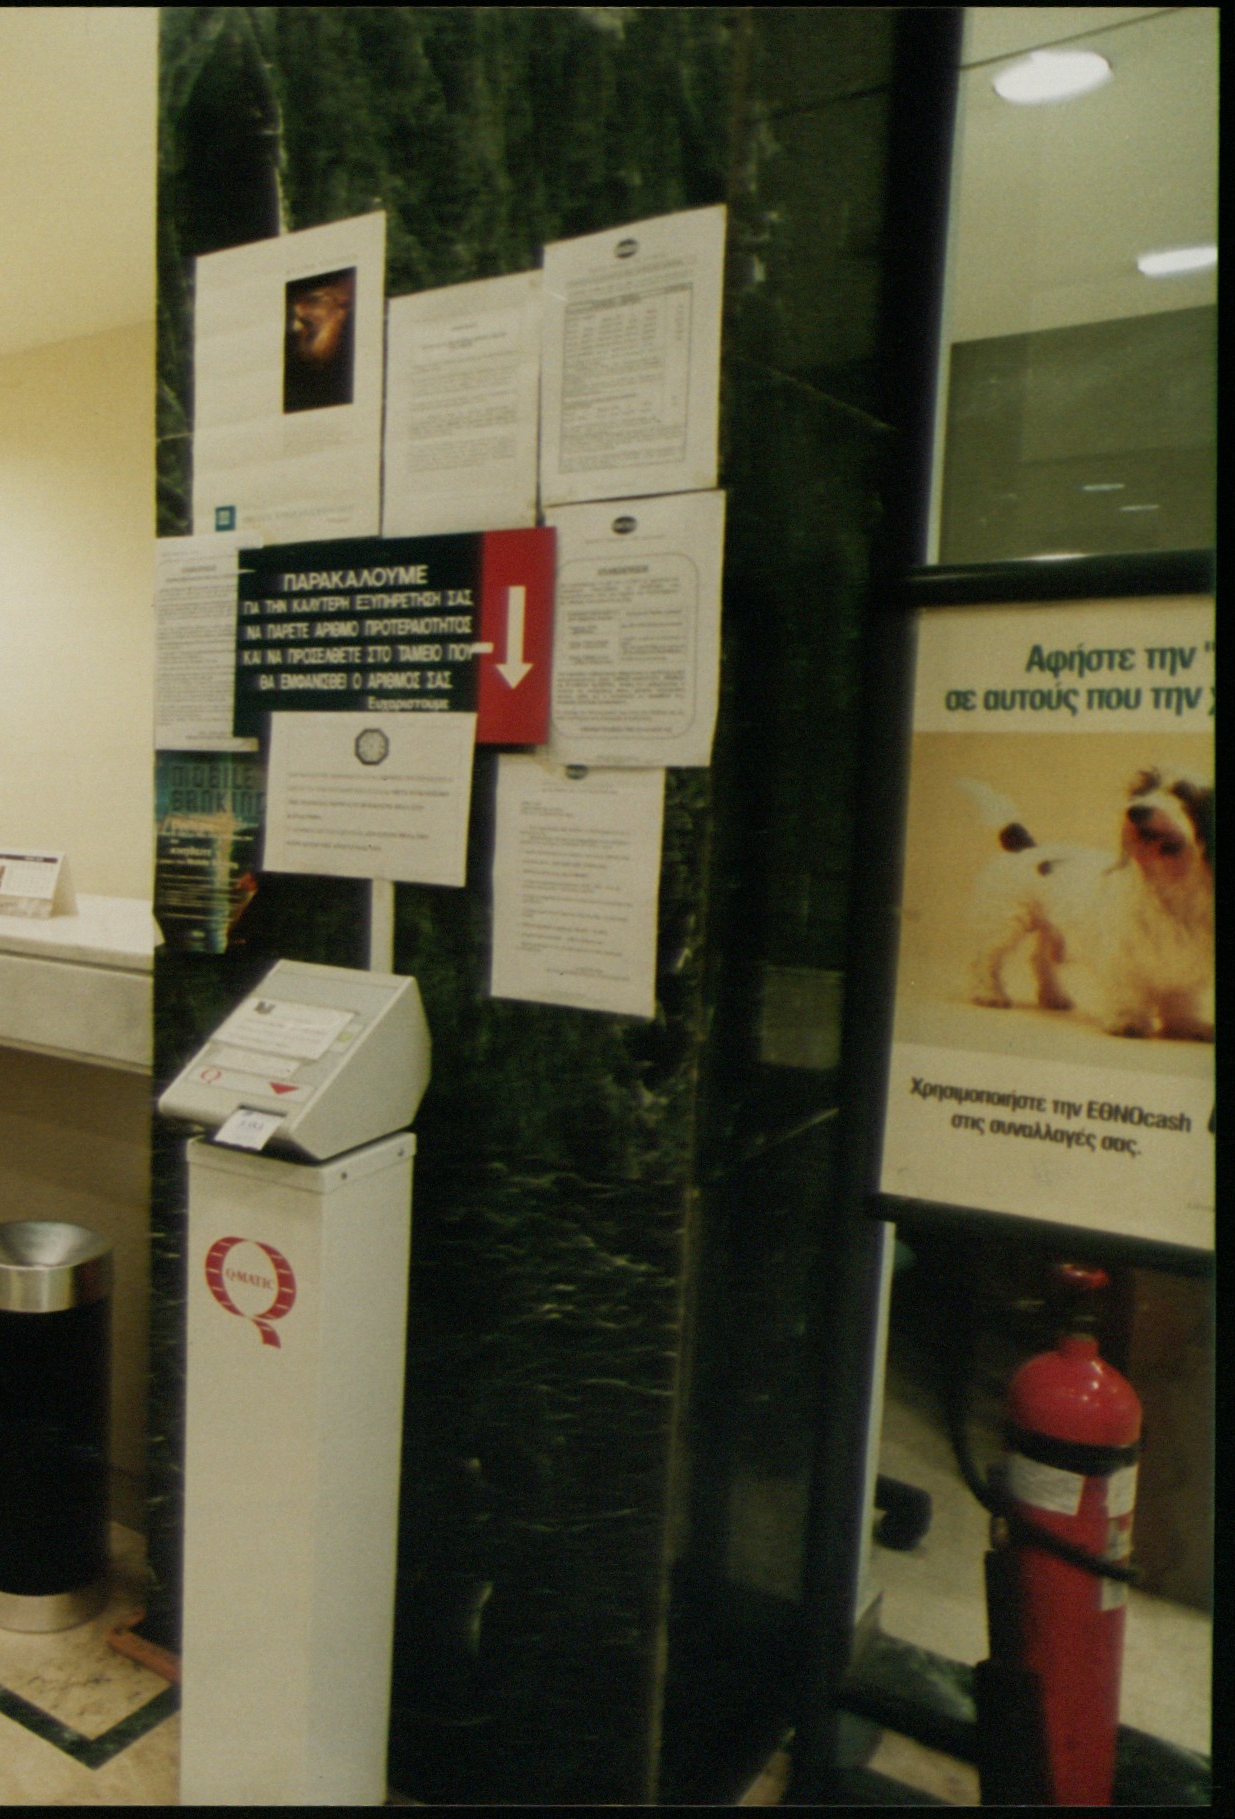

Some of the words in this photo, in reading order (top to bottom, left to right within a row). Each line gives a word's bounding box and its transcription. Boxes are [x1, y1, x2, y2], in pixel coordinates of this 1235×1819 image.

[283, 564, 429, 592] ΠΑΡΑΚΑΛΟΥΜΕ
[243, 600, 260, 615] ΓΙΑ
[265, 598, 288, 614] ΤΗΝ
[292, 596, 351, 613] ΚΑΛΥΤΕΡΗ
[356, 591, 441, 610] ΕΞΥΠΗΡΕΤΗΣΗ
[448, 589, 474, 606] ΣΑΣ
[246, 625, 262, 640] ΝΑ
[267, 622, 310, 639] ΠΑΡΕΤΕ
[314, 620, 359, 638] ΑΡΙΘΜΟ
[364, 616, 473, 636] ΠΡΟΤΕΡΑΙΟΤΗΤΟΣ
[242, 649, 261, 665] ΚΑΙ
[267, 649, 282, 664] ΝΑ
[286, 647, 362, 664] ΠΡΟΣΕΛΘΕΤΕ
[367, 645, 392, 663] ΣΤΟ
[397, 644, 443, 662] ΤΑΜΕΙΟ
[1025, 641, 1137, 679] Αφήστε
[1144, 646, 1197, 677] την
[259, 674, 275, 690] ΘΑ
[352, 672, 362, 689] Ο
[367, 671, 421, 689] ΑΡΙΘΜΟΣ
[426, 670, 454, 689] ΣΑΣ
[944, 689, 977, 712] σε
[982, 681, 1080, 717] αυτούς
[1086, 687, 1143, 711] που
[1150, 686, 1203, 717] την
[910, 1076, 1047, 1113] Χρησιμοποιήστε
[1051, 1098, 1084, 1121] την
[951, 1112, 986, 1136] στις
[989, 1118, 1097, 1151] συναλλαγές
